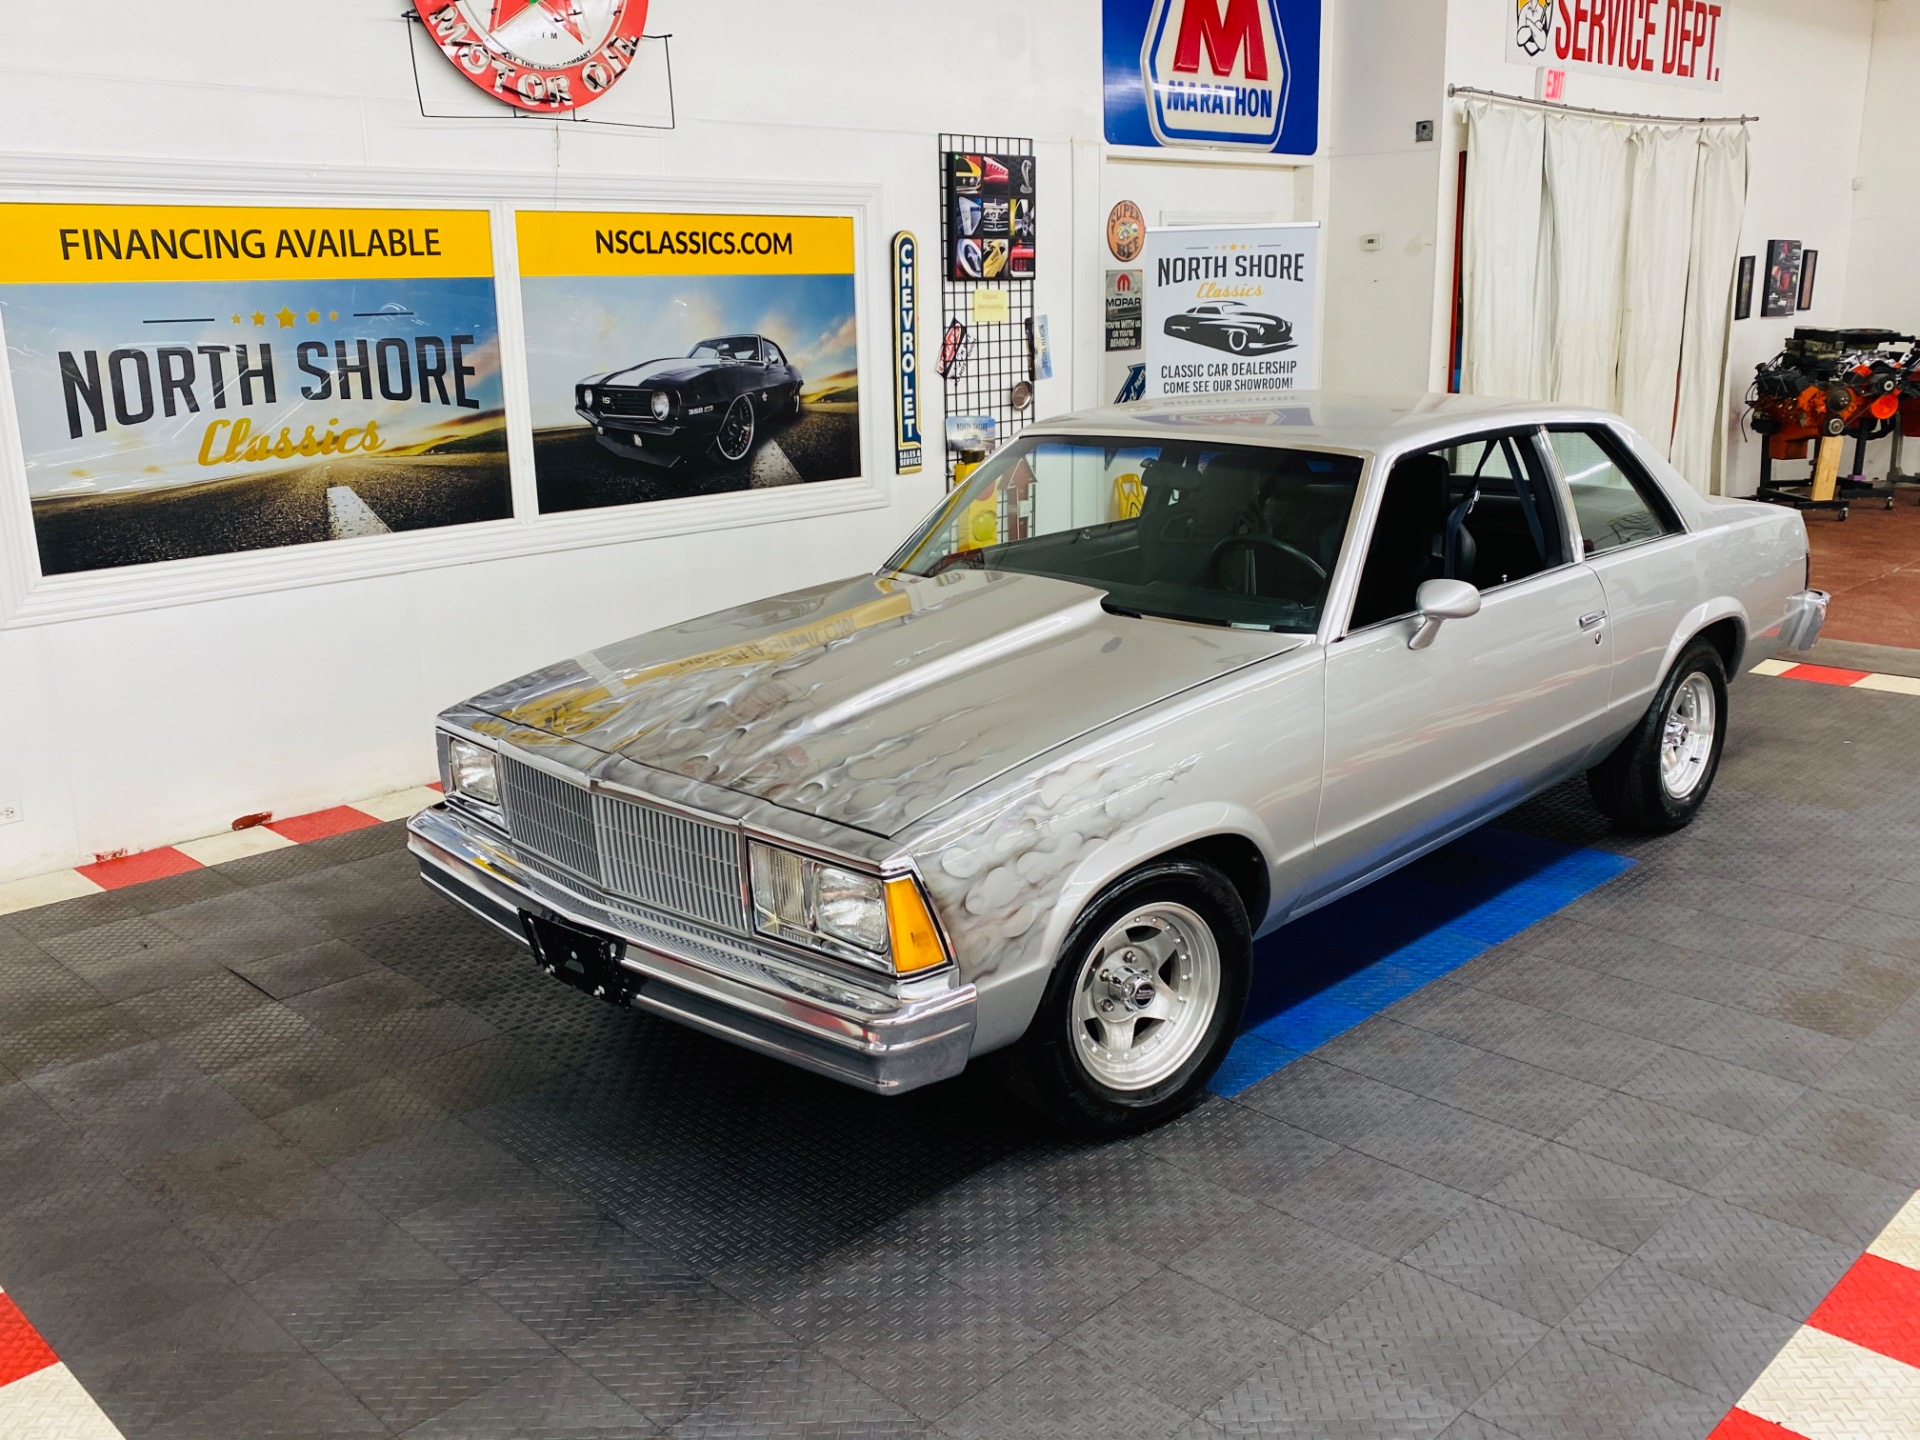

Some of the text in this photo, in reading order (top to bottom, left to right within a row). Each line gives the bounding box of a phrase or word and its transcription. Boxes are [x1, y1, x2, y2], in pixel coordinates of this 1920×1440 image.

[427, 5, 638, 108] MOTOR OIL
[1172, 0, 1268, 81] M
[1555, 0, 1722, 82] SERVICE DEPT.
[1167, 80, 1273, 118] MARATHON
[1545, 69, 1565, 99] EXIT
[1110, 203, 1141, 235] SUPER
[59, 228, 442, 260] FINANCING AVAILABLE
[595, 229, 793, 255] NSCLASSICS.COM
[1158, 253, 1305, 287] NORTH SHORE
[1105, 297, 1141, 307] MOPAR
[1196, 281, 1264, 299] Classics
[900, 243, 916, 438] CHEVROLET
[1038, 324, 1046, 347] NORTH
[1161, 360, 1297, 379] CLASSIC CAR DEALERSHIP
[1163, 377, 1293, 394] COME SEE OUR SHOWROOM!
[58, 334, 481, 440] NORTH SHORE
[198, 416, 387, 467] Classics
[900, 456, 922, 466] SERVICE
